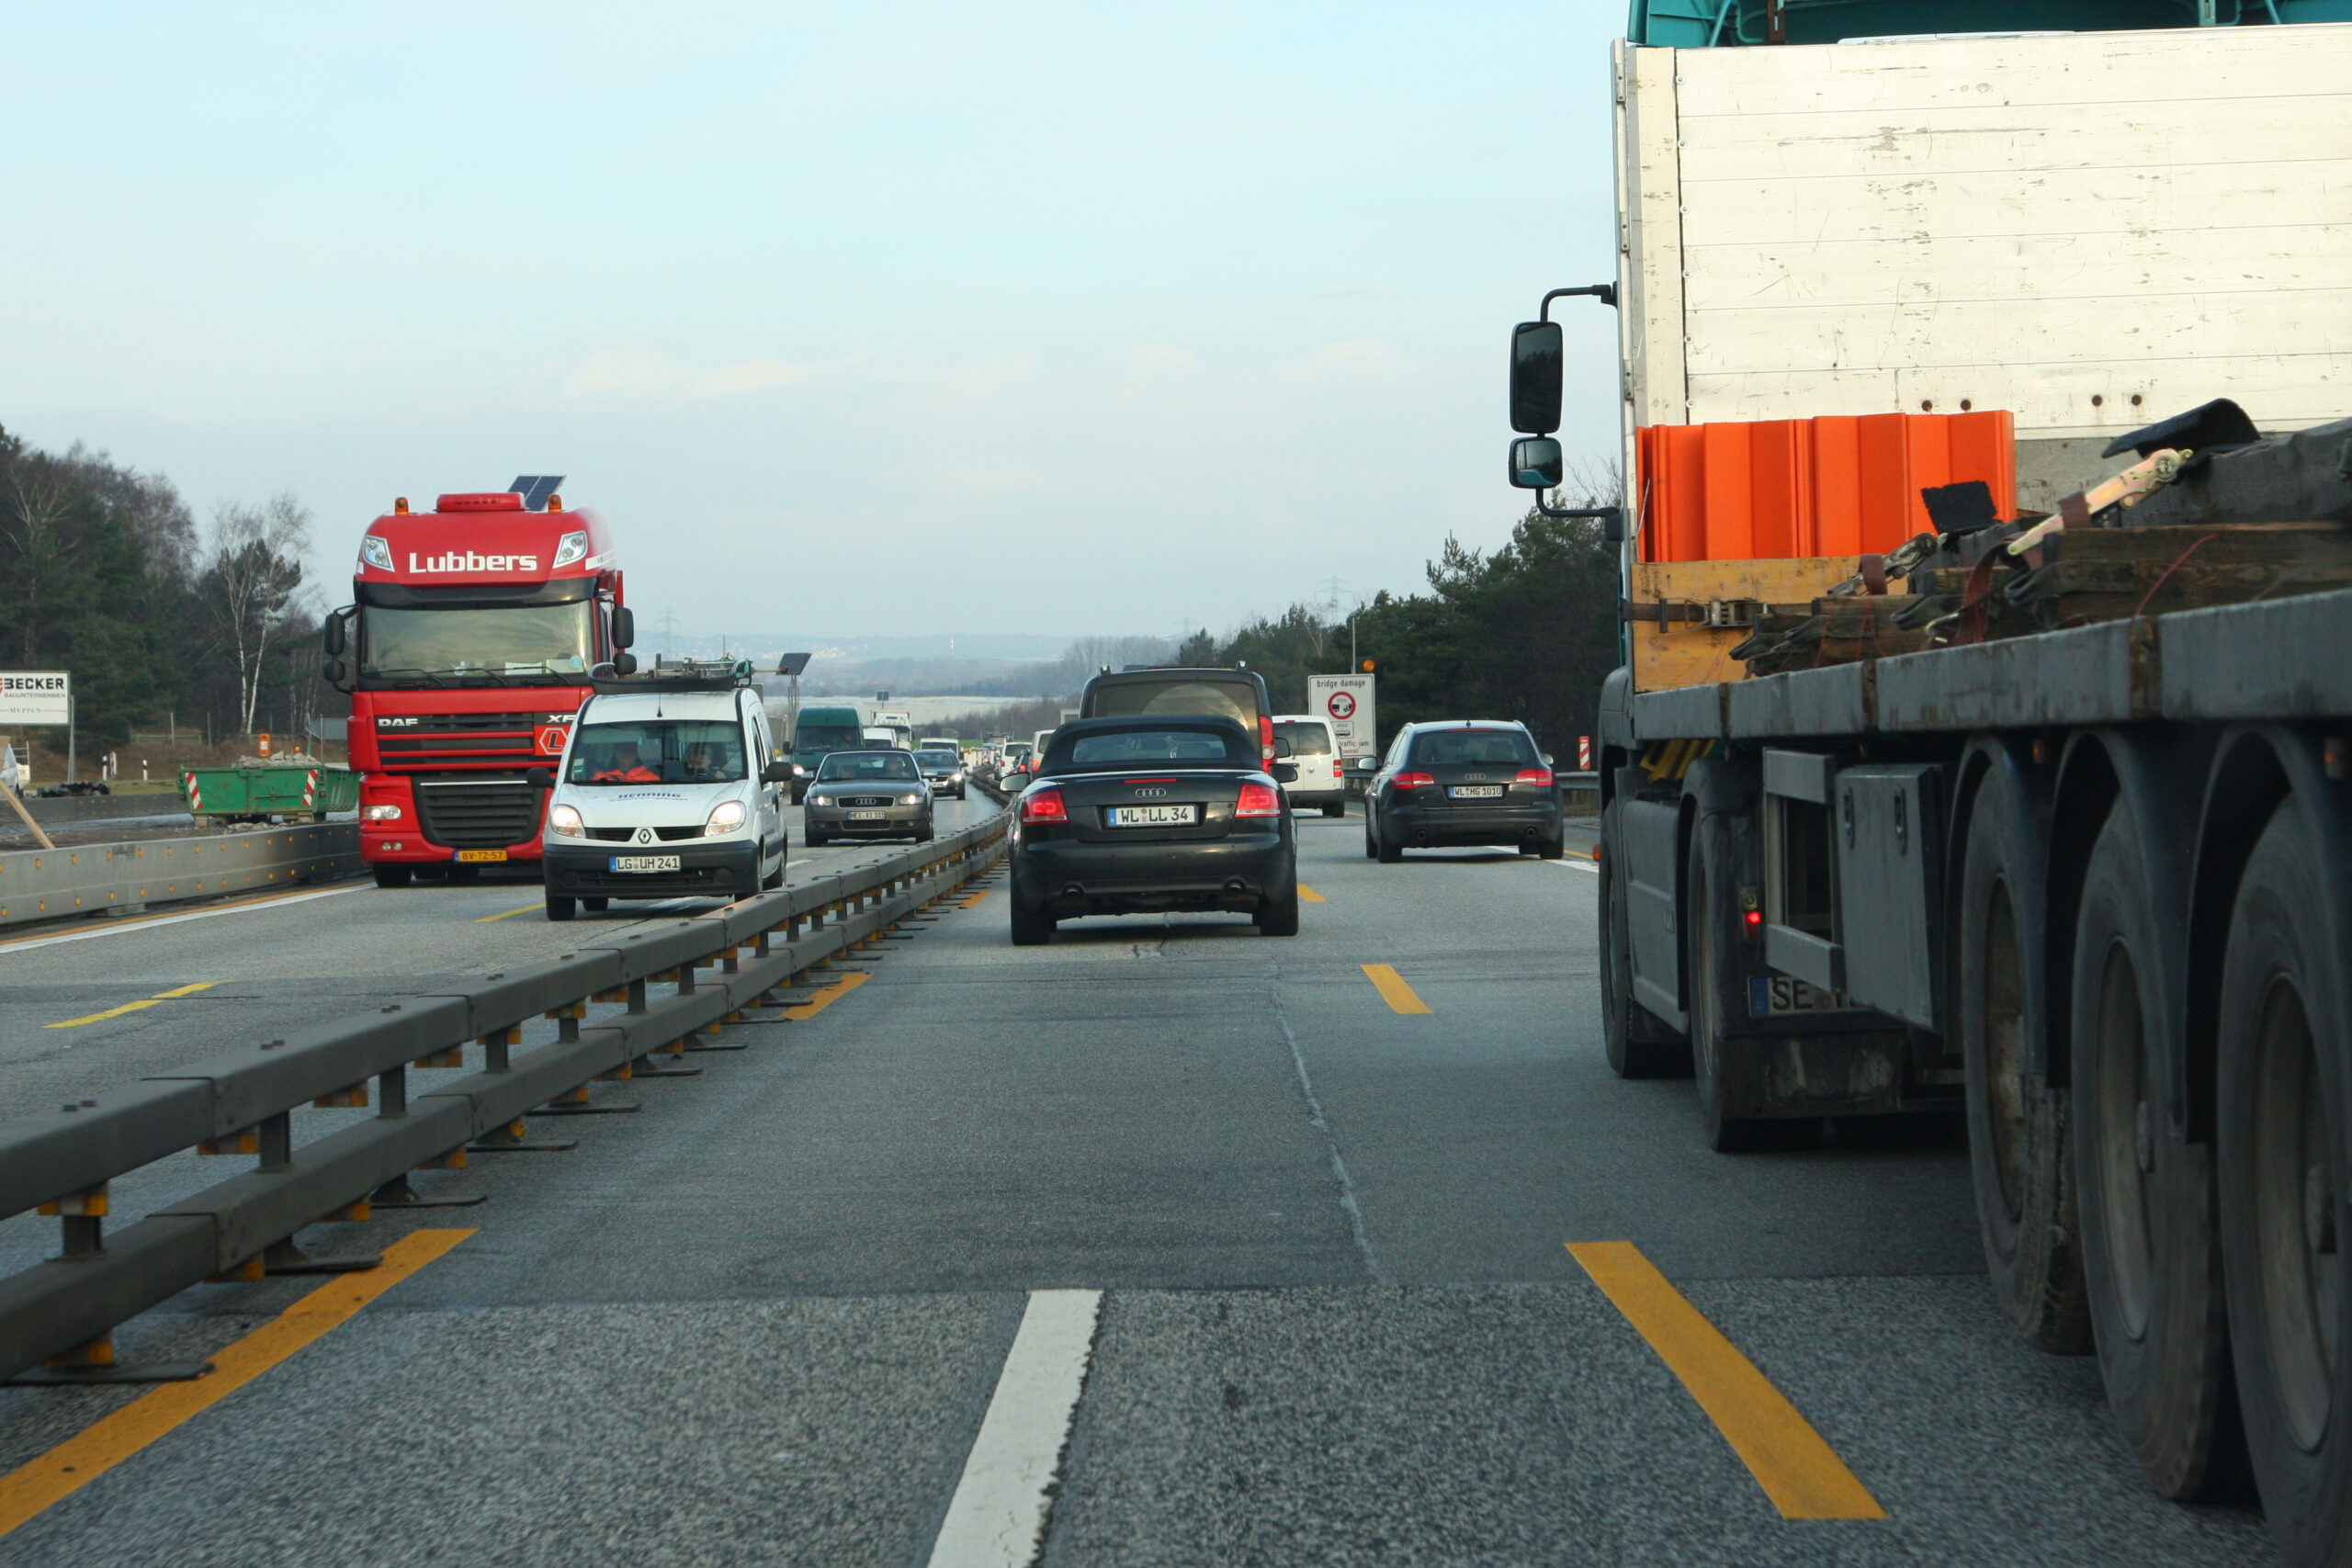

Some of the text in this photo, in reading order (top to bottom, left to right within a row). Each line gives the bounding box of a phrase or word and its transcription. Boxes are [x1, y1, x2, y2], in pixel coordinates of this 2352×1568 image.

[410, 551, 537, 573] Lubbers
[4, 678, 64, 690] BECKER
[1317, 680, 1365, 689] bridge damage
[379, 718, 418, 727] DAF
[1121, 807, 1189, 823] WL LL 34
[616, 857, 679, 870] LG UH 241
[1772, 976, 1814, 1010] SE
